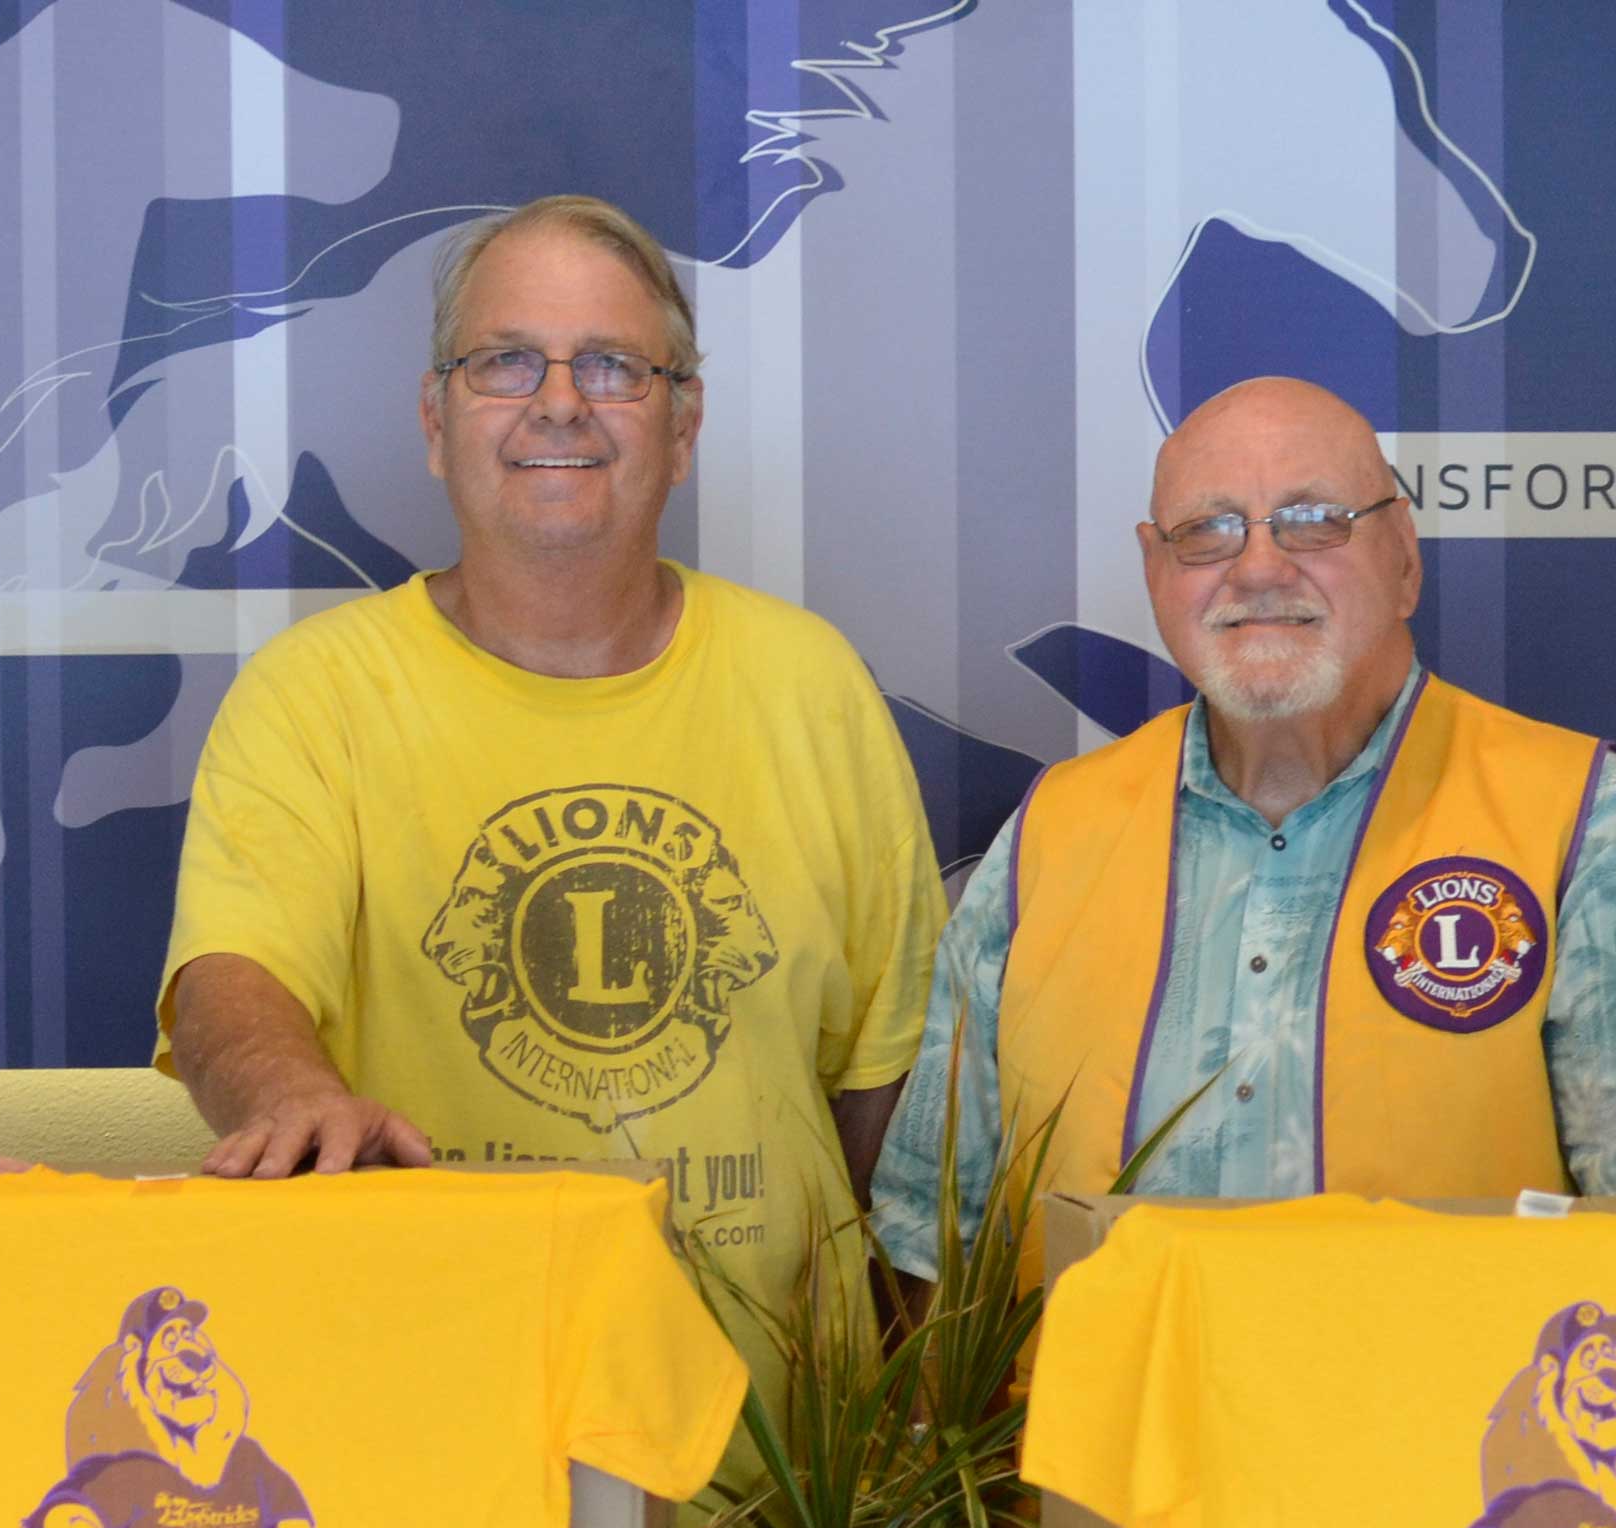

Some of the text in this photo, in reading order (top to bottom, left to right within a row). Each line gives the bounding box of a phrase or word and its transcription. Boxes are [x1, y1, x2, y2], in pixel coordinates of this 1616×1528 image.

[497, 798, 702, 862] LIONS
[1415, 879, 1497, 908] LIONS
[563, 890, 651, 1003] L
[1434, 914, 1480, 968] L
[1411, 966, 1506, 1001] INTERNATIONAL
[499, 1029, 697, 1101] INTERNATIONAL
[704, 1143, 765, 1211] you!
